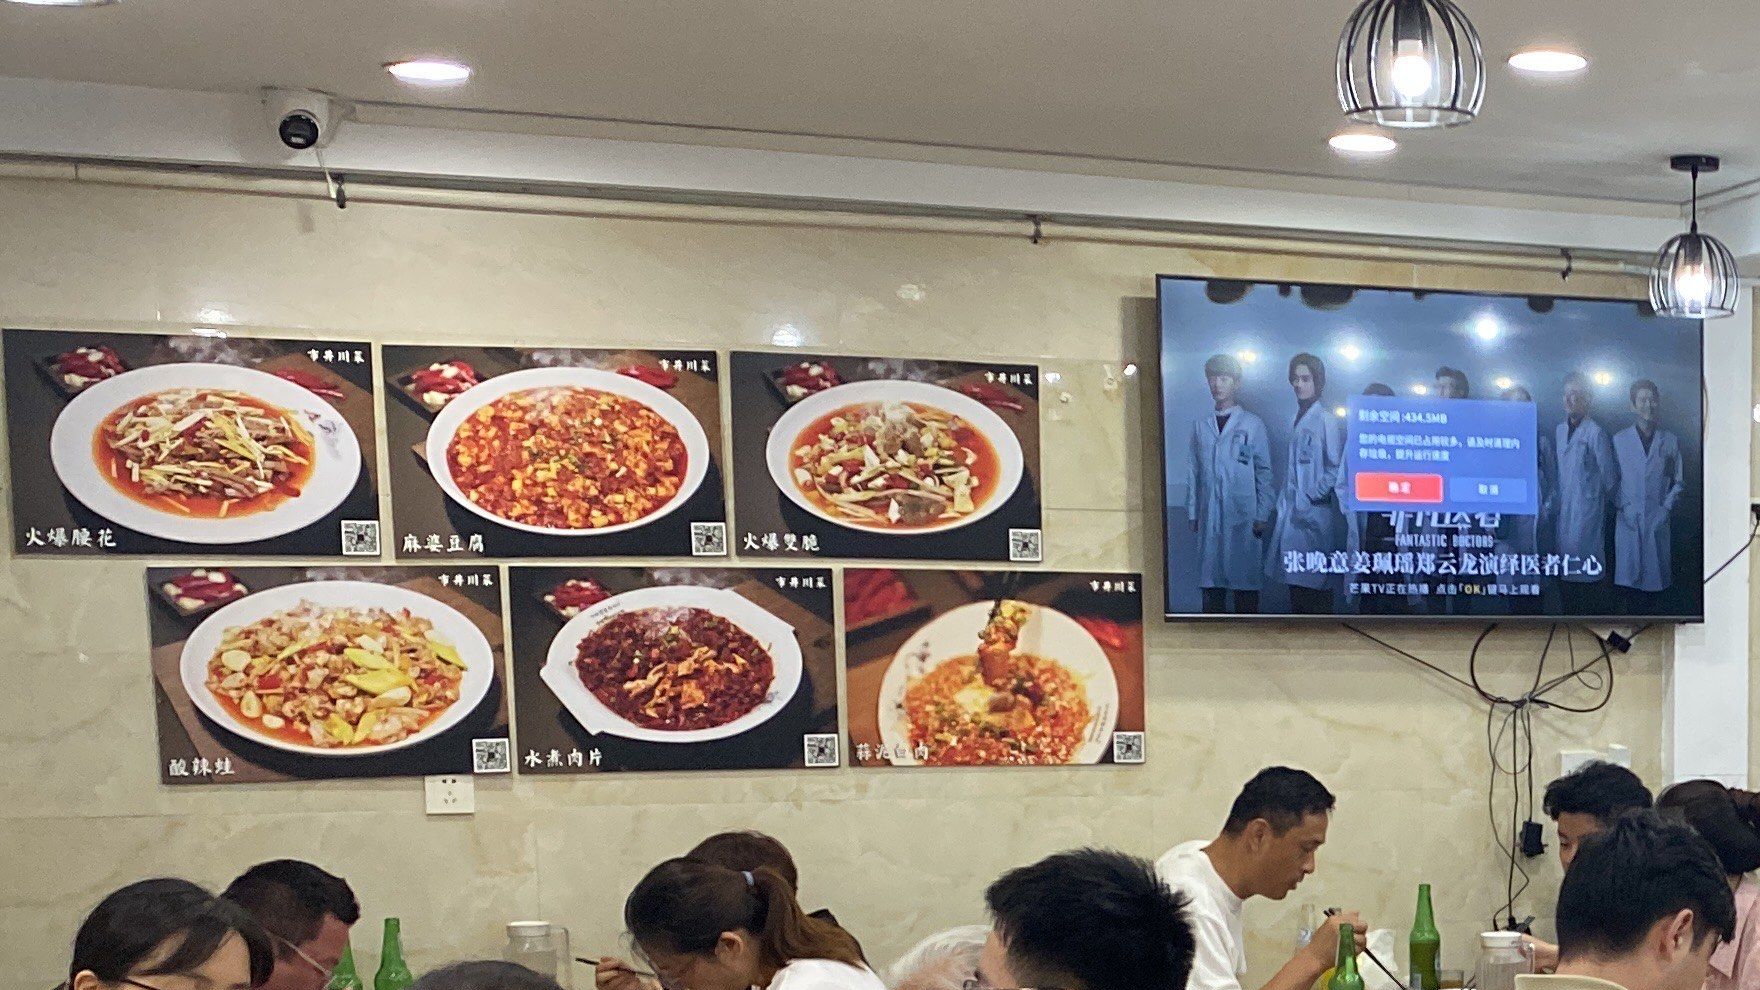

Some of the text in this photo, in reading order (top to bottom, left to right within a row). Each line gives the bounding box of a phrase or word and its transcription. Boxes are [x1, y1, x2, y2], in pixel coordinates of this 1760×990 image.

[307, 348, 365, 364] 市井川菜
[24, 526, 117, 548] 火爆腰花
[402, 533, 485, 553] 麻婆豆腐
[1395, 534, 1447, 547] FANTASTIC
[438, 573, 494, 587] 市井川菜
[168, 756, 235, 778] 酸辣蛙
[524, 748, 602, 768] 水煮肉片
